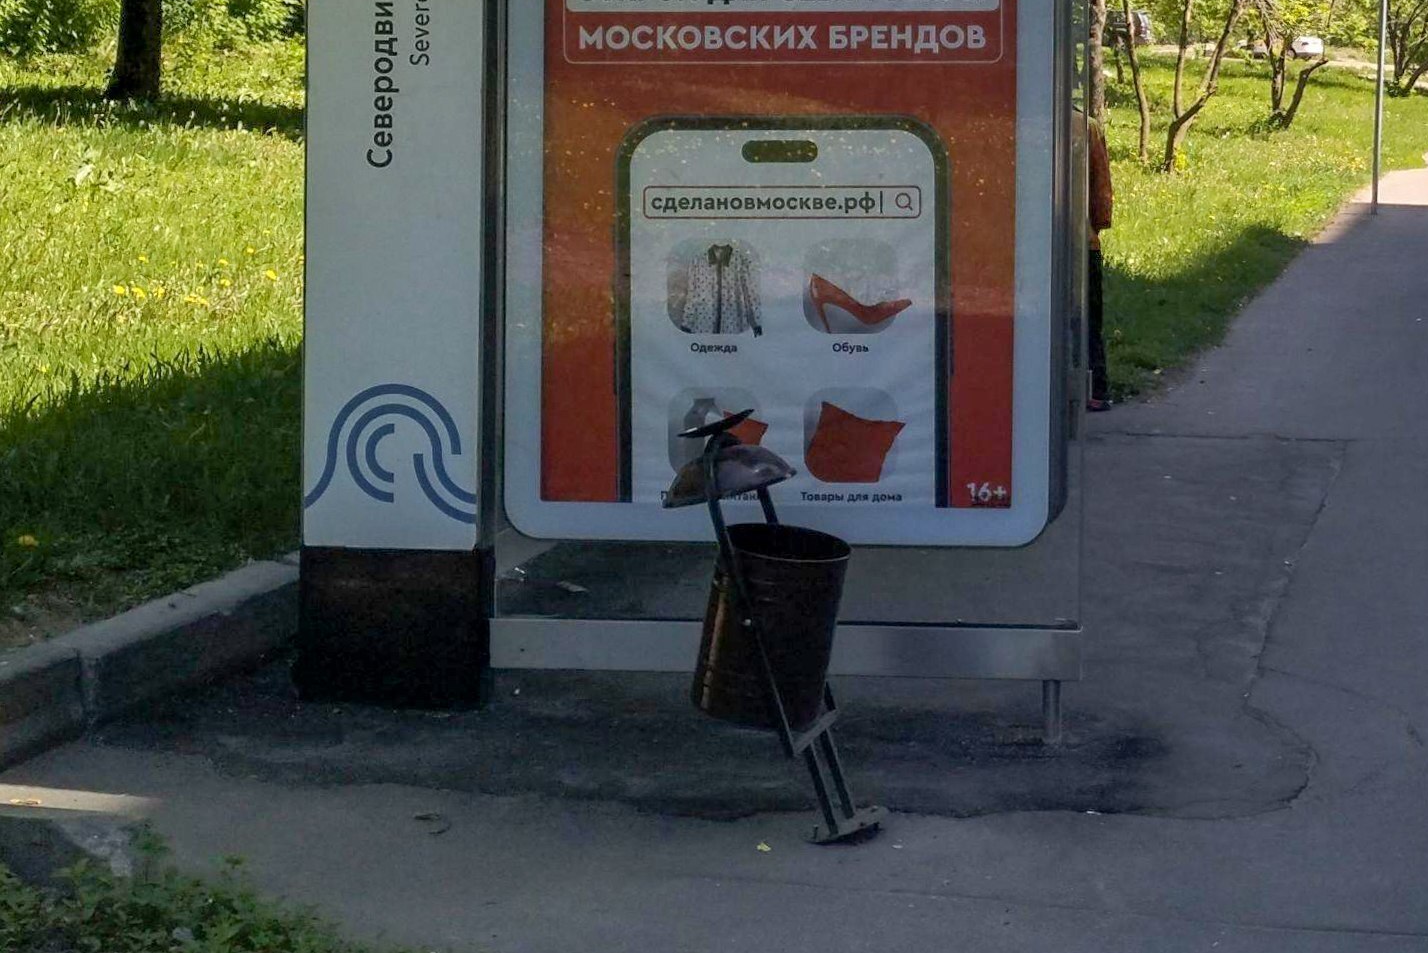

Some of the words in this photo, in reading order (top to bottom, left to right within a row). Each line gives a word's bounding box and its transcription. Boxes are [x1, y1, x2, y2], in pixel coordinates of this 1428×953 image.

[578, 24, 818, 51] МОСКОВСКИХ
[828, 25, 987, 55] БРЕНДОВ
[650, 190, 876, 214] сделановмоскве.рф
[690, 342, 738, 353] Одежда
[832, 342, 870, 354] Обувь
[800, 491, 845, 503] Товары
[846, 493, 869, 503] для
[871, 493, 903, 503] дома
[966, 482, 1007, 502] 16+
